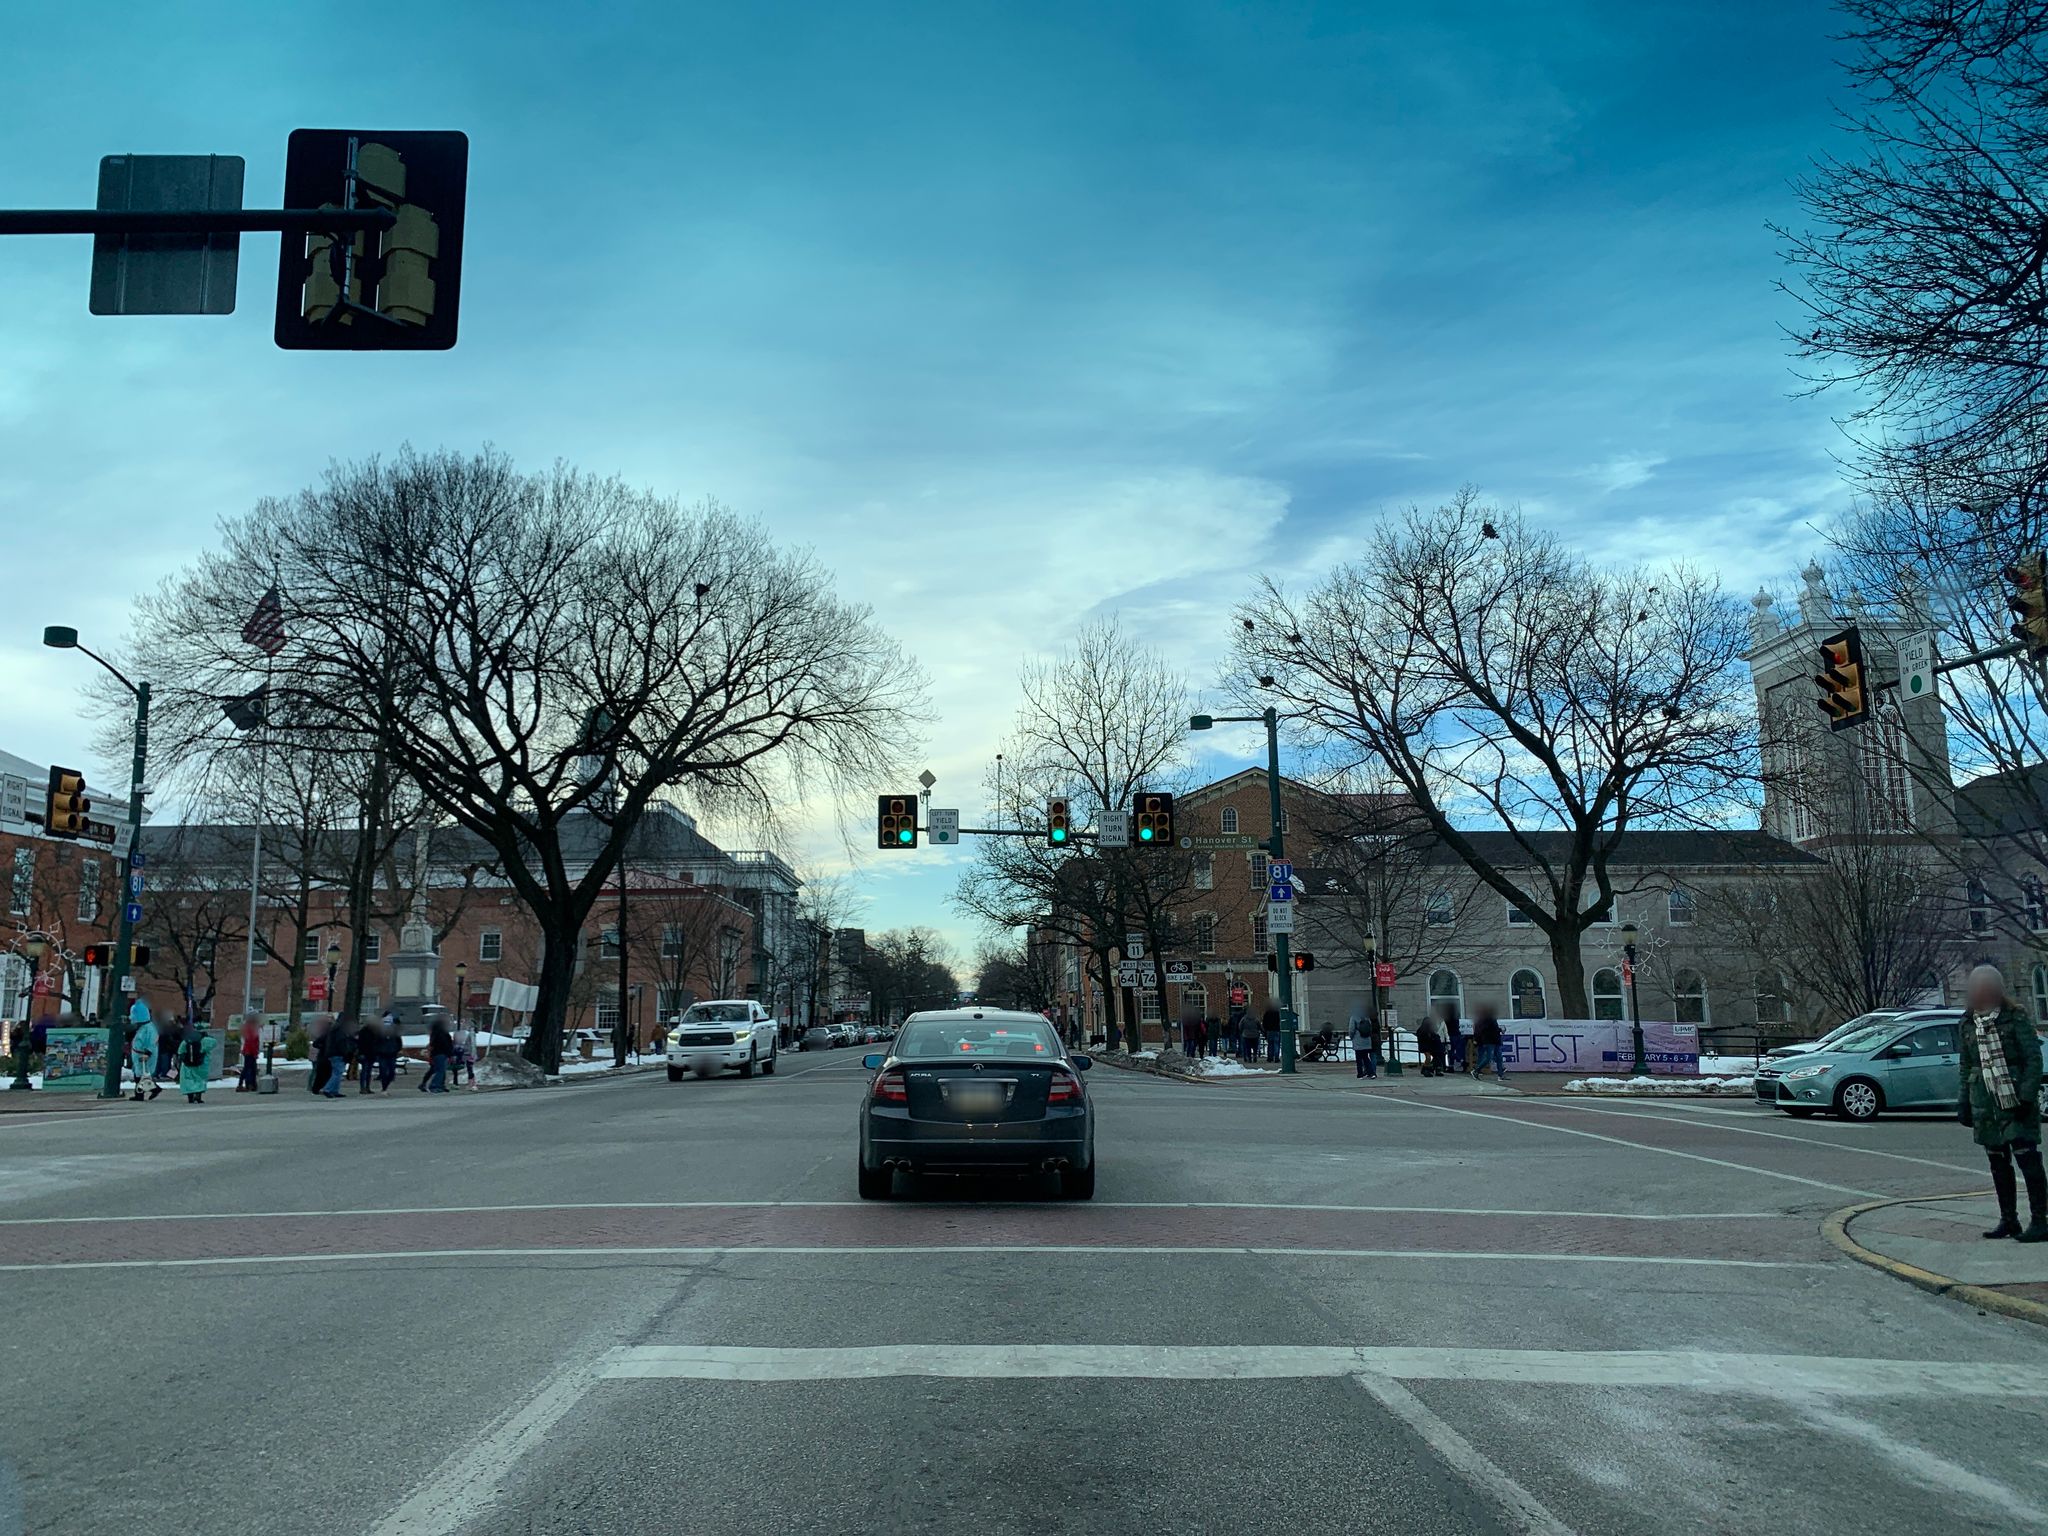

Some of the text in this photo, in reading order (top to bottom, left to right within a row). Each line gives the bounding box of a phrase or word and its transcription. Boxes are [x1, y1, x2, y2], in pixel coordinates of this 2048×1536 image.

[1899, 635, 1927, 651] LEFT TURN
[1904, 647, 1923, 662] YIELD
[1903, 660, 1928, 674] ON GREEN
[6, 780, 23, 791] RIGHT
[7, 793, 21, 804] TURN
[2, 805, 20, 817] SIGNAL
[1195, 836, 1252, 844] Hanover St
[1272, 865, 1288, 878] 81
[132, 876, 142, 891] 81
[1131, 945, 1140, 956] 11
[1121, 974, 1139, 984] 641
[1143, 974, 1155, 984] 74
